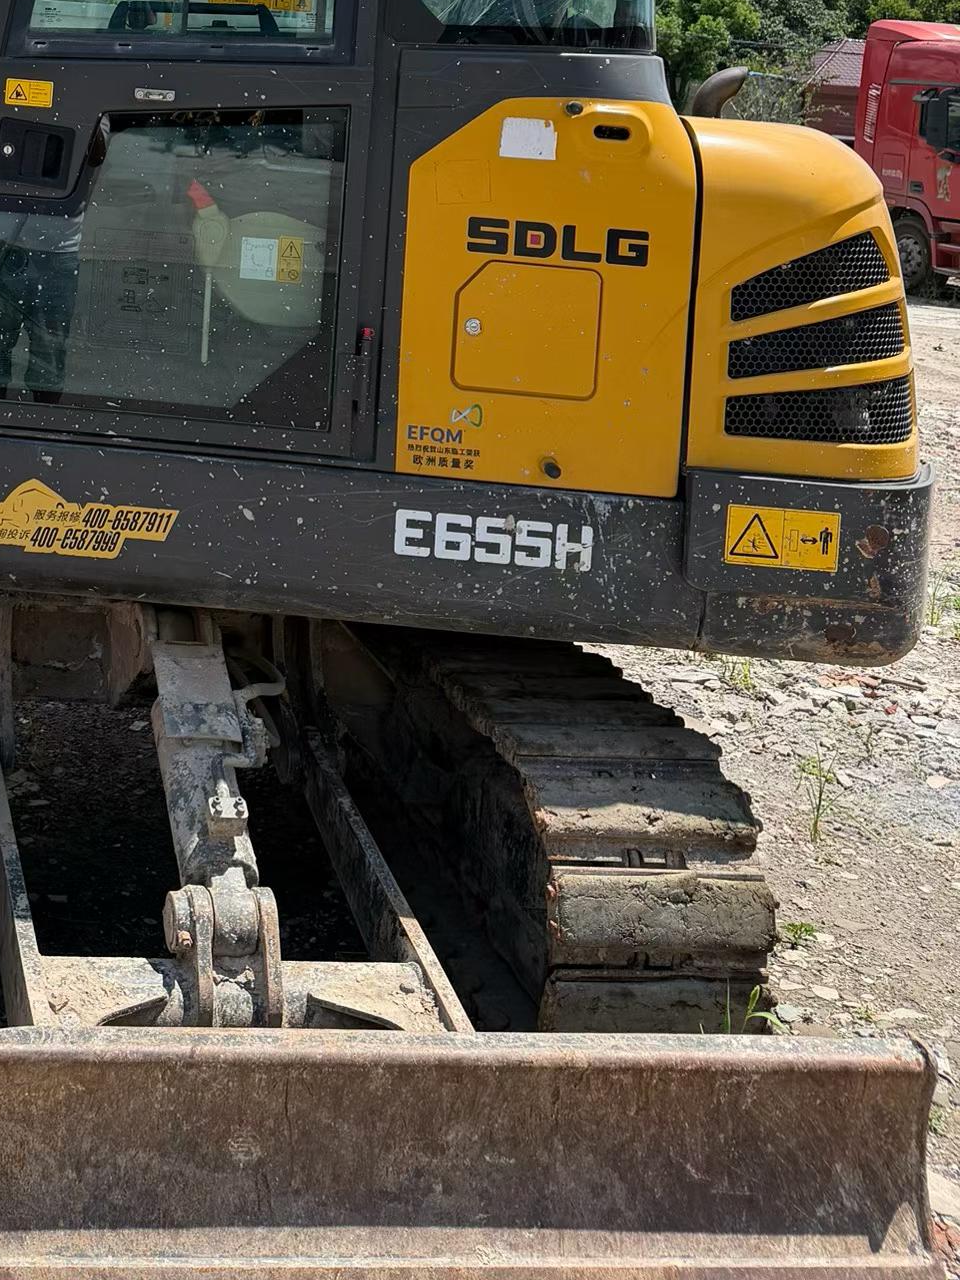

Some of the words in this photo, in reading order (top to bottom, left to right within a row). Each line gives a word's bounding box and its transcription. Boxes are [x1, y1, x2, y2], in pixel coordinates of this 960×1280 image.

[467, 216, 650, 267] SDLG
[407, 424, 463, 444] EFQM
[412, 454, 474, 470] 欧洲质量奖
[30, 526, 122, 553] 400-6587999
[394, 508, 594, 572] E655H
